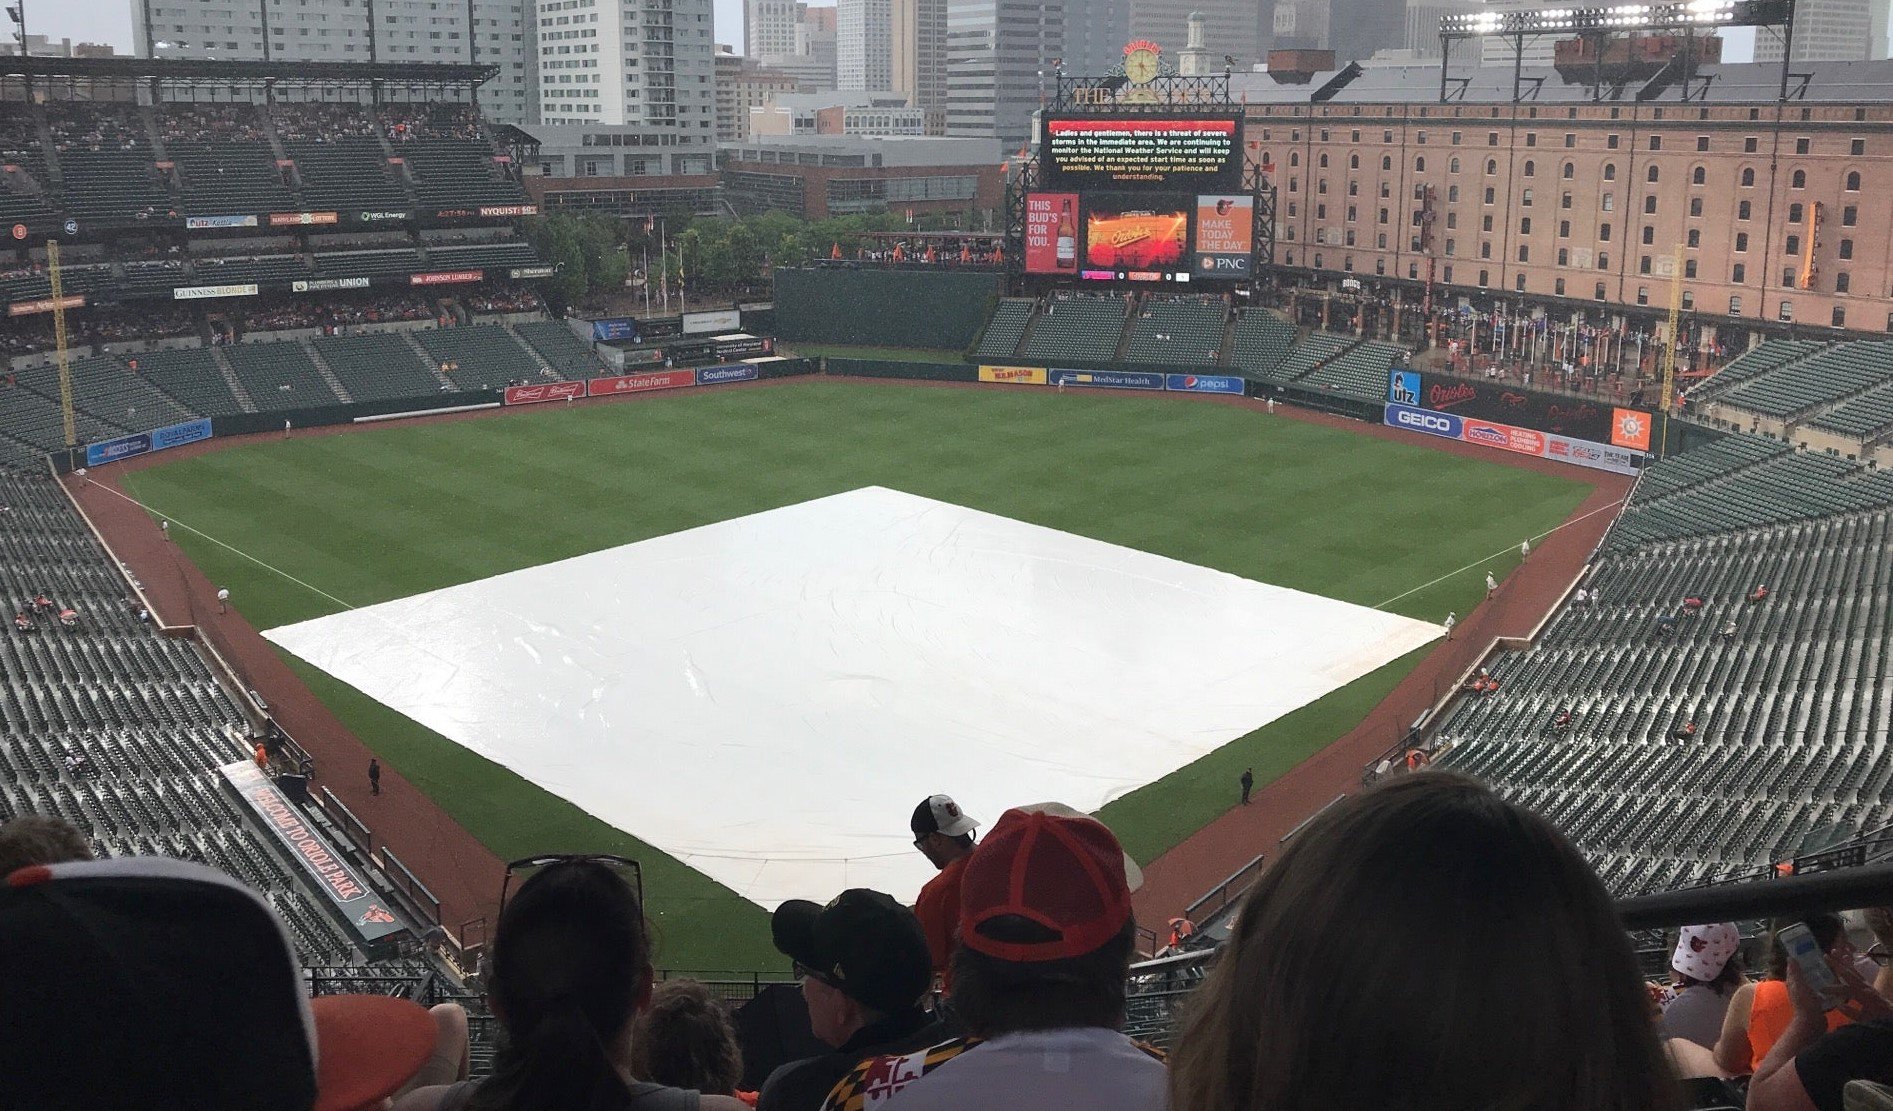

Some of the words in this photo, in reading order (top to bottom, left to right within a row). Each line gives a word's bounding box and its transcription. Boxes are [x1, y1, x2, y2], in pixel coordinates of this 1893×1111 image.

[1074, 88, 1111, 104] THE
[1094, 130, 1133, 138] gentlemen,
[1183, 139, 1221, 147] continuing
[1116, 156, 1149, 164] expected
[1028, 200, 1051, 211] THIS
[385, 211, 407, 220] Energy
[481, 207, 520, 216] NYQUIST:
[1029, 212, 1058, 223] BUD'S
[66, 223, 76, 231] 42
[1029, 224, 1047, 234] FOR
[1202, 220, 1232, 229] MAKE
[1202, 230, 1234, 239] TODAY
[1028, 236, 1050, 247] YOU.
[1202, 241, 1221, 249] THE
[1223, 241, 1243, 250] DAY
[1217, 258, 1245, 269] PNC
[340, 277, 369, 287] UNION
[175, 289, 215, 299] GUINNESS
[216, 287, 247, 295] BLONDE
[703, 369, 746, 380] Southwest
[1093, 376, 1123, 384] MedStar
[1125, 377, 1150, 385] Health
[1200, 380, 1229, 389] pepsi
[1430, 384, 1476, 408] Orioles
[1398, 411, 1450, 431] GEICO
[1469, 429, 1508, 444] HORIZON
[255, 787, 300, 829] WELCOME
[286, 826, 309, 841] TO
[297, 839, 339, 874] ORIOLE
[327, 870, 362, 900] PARK
